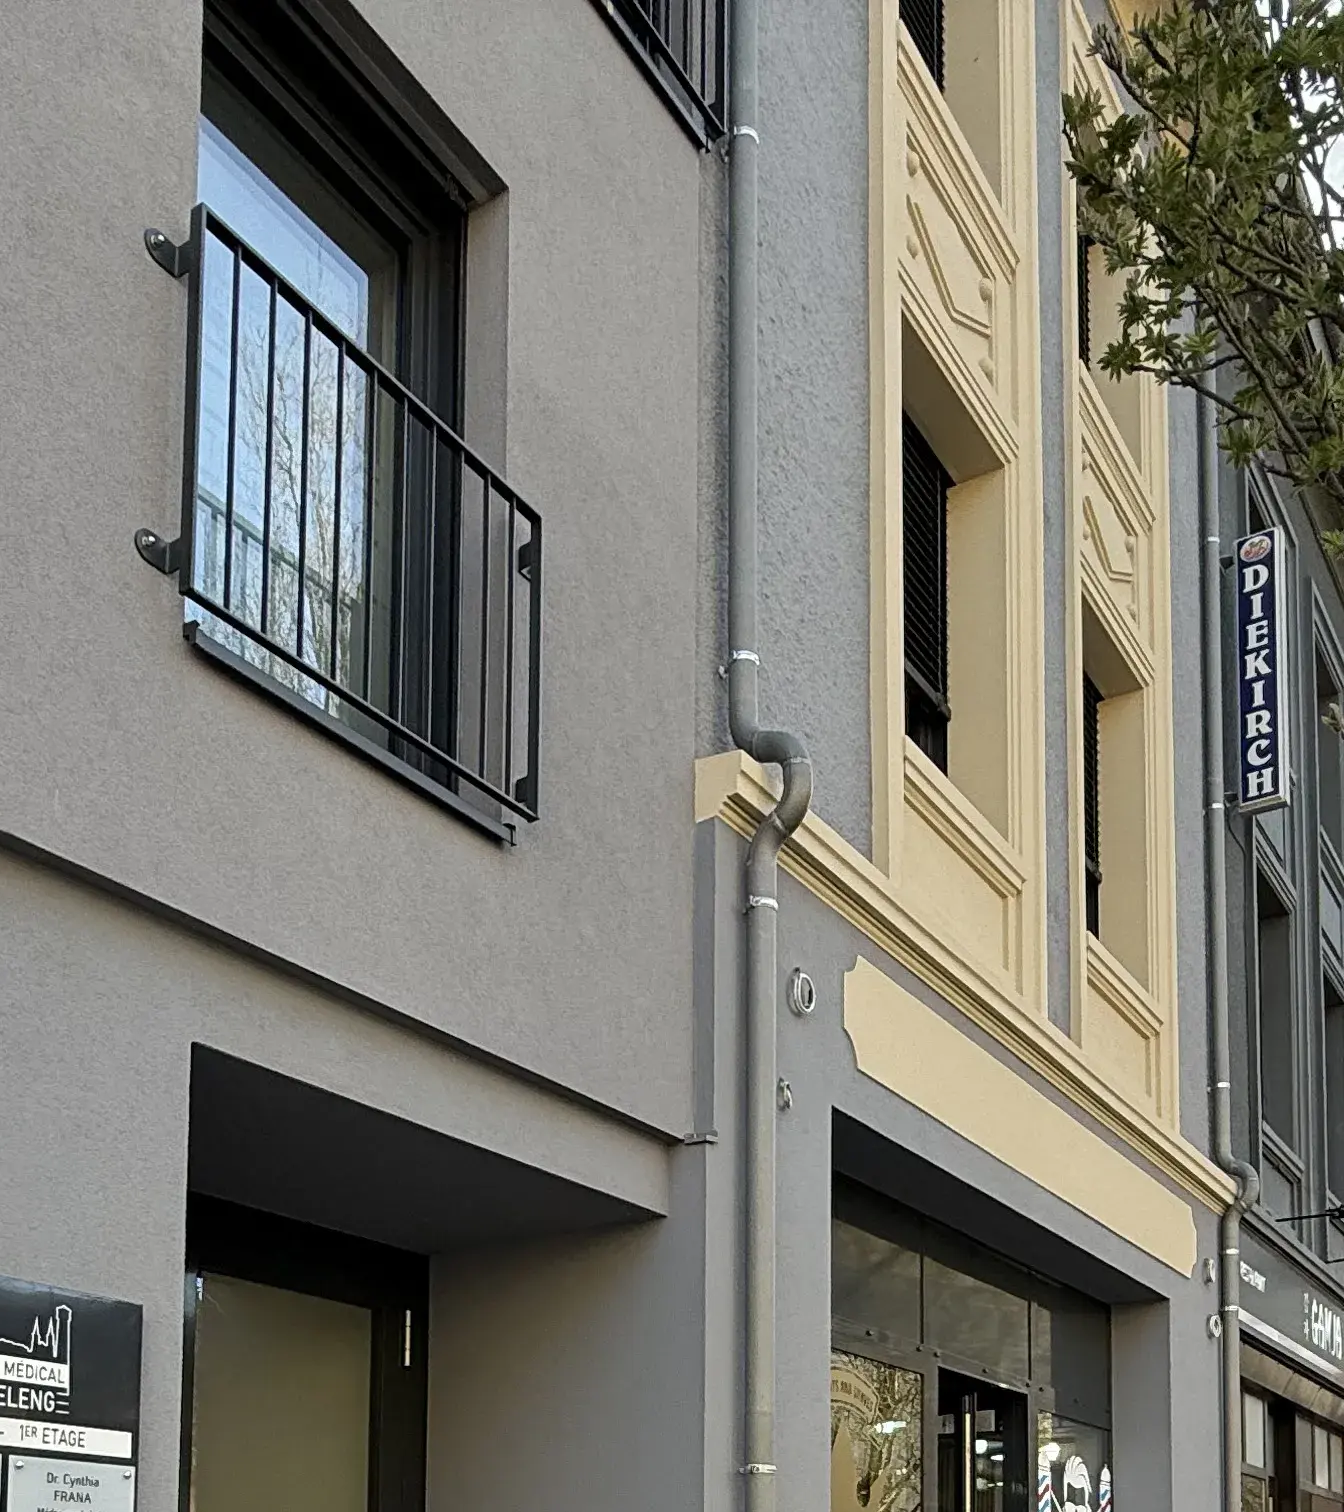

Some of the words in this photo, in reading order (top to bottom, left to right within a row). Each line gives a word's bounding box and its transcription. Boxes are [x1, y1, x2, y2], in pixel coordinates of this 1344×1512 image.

[1242, 564, 1275, 798] DIEKIRCH
[4, 1359, 65, 1384] MÉDICAL
[42, 1427, 86, 1448] ETAGE
[63, 1473, 99, 1488] Cynthia
[54, 1490, 92, 1503] FRANA
